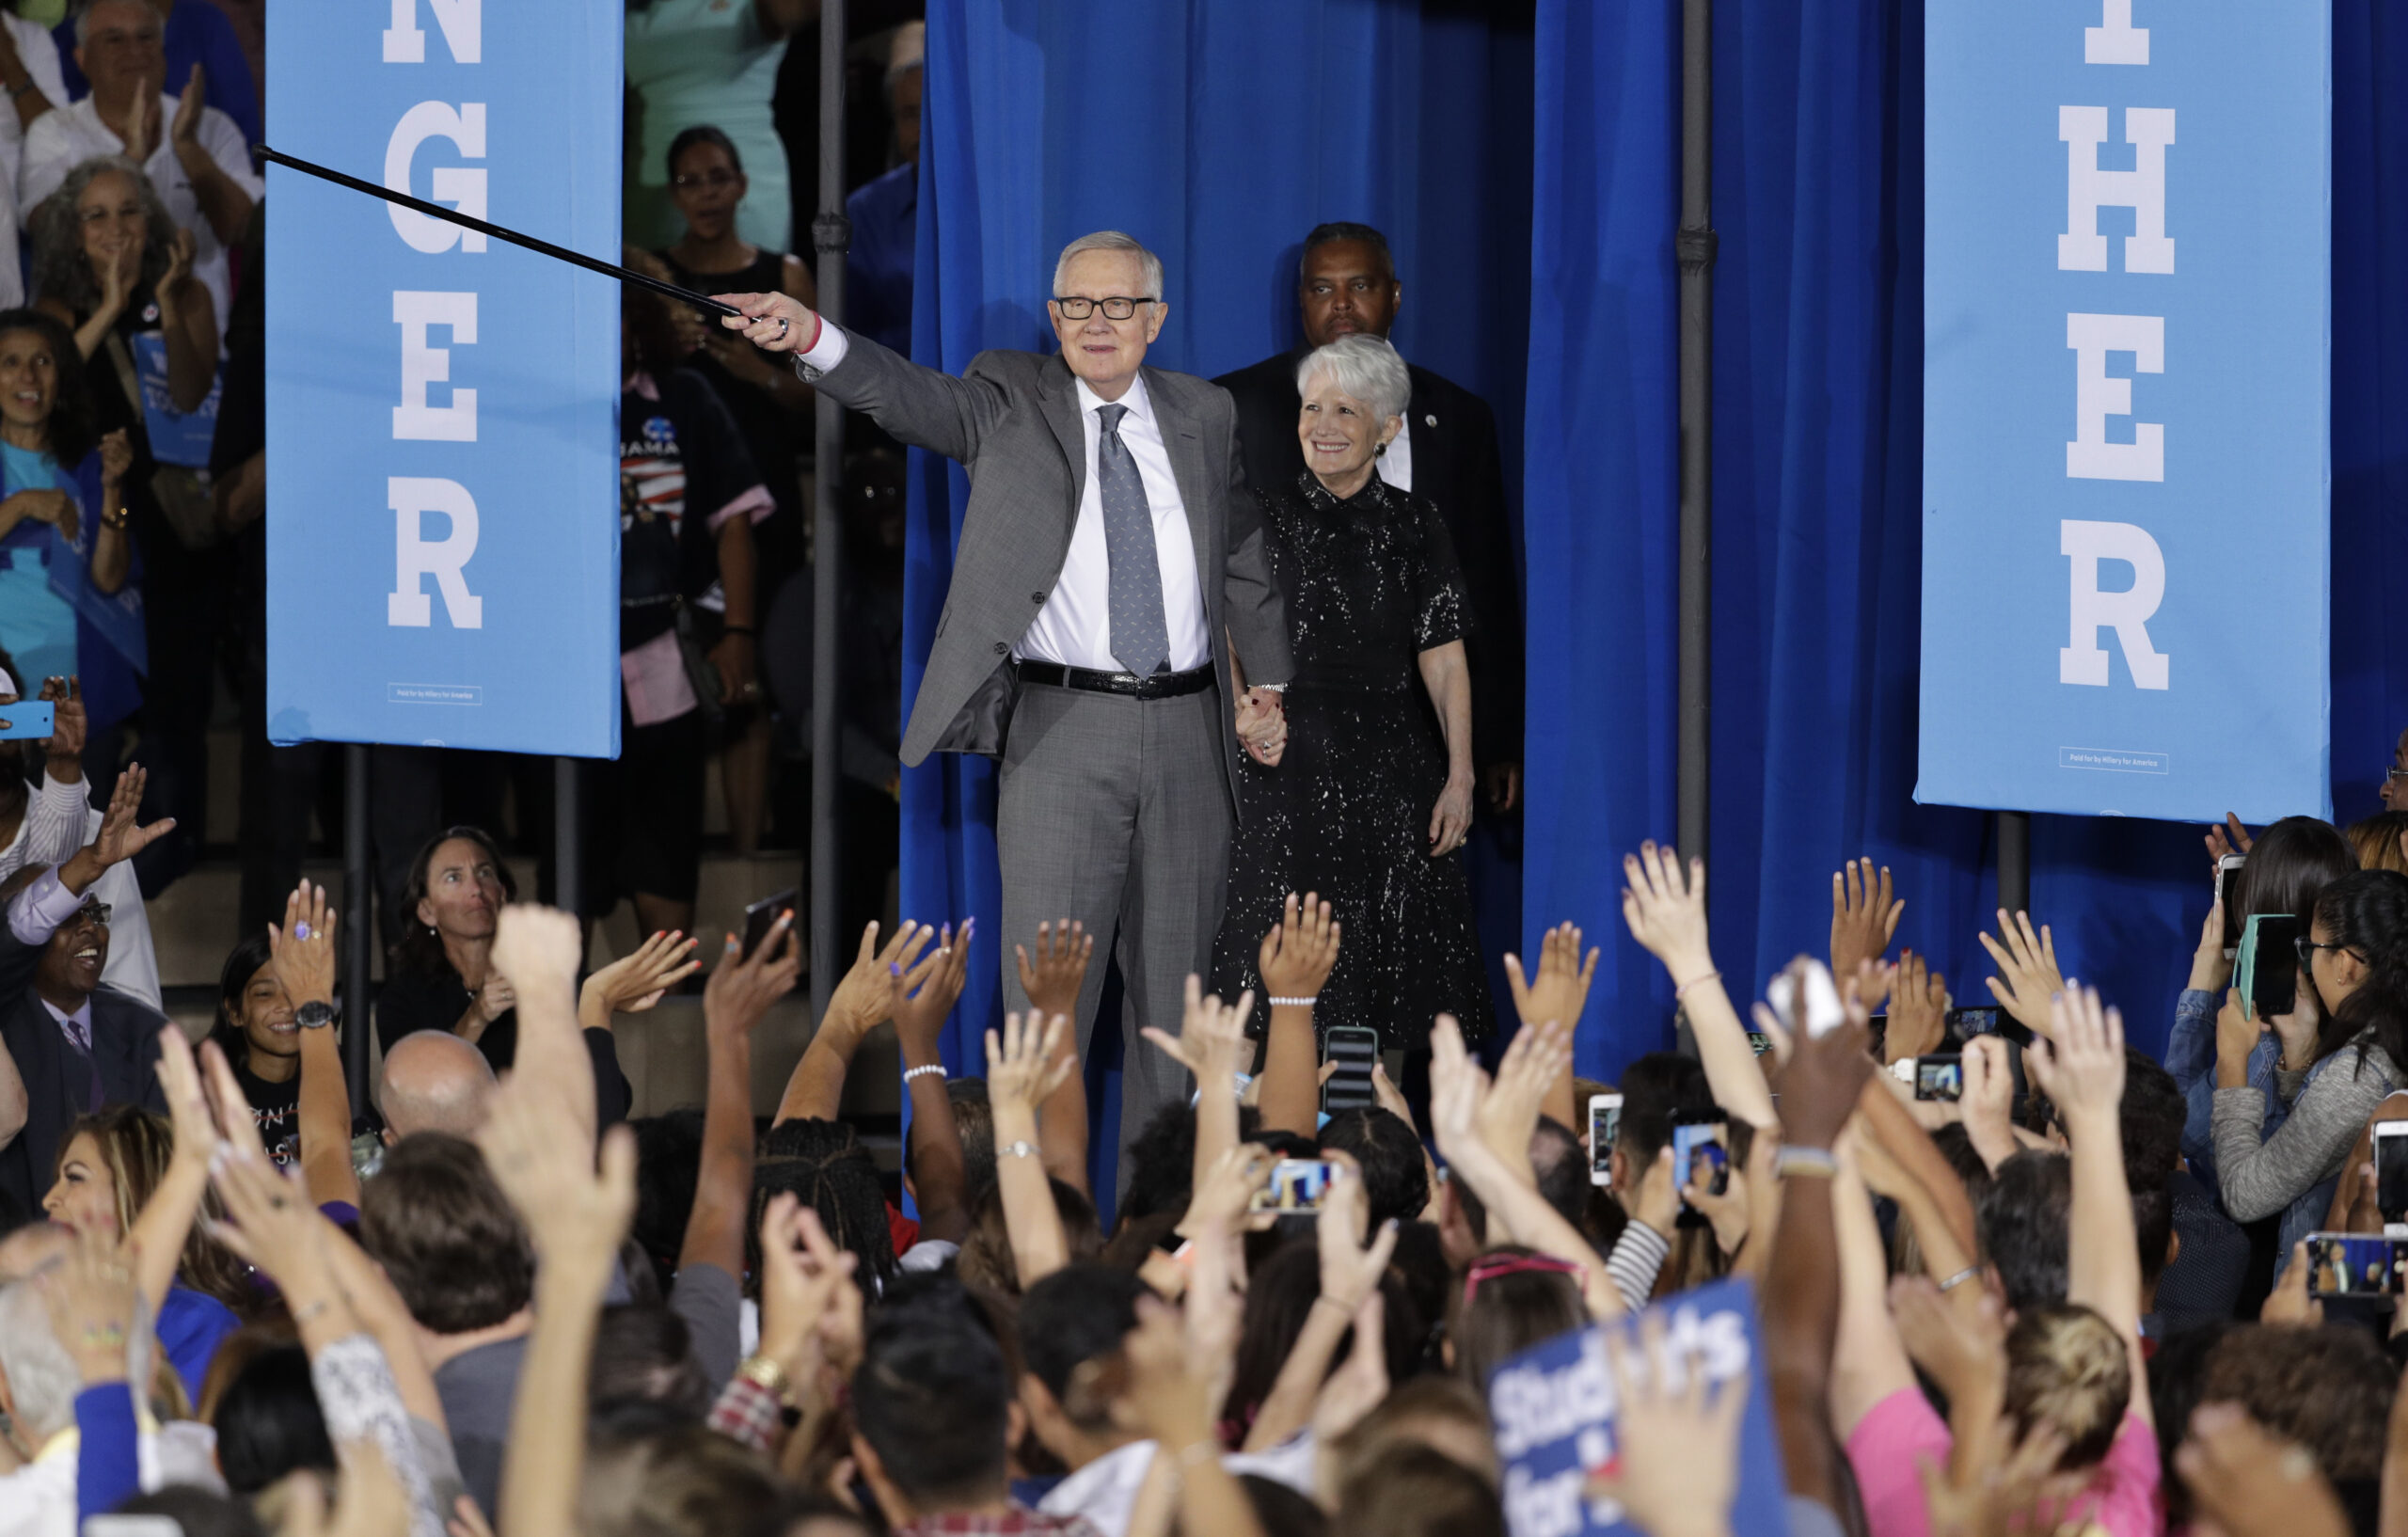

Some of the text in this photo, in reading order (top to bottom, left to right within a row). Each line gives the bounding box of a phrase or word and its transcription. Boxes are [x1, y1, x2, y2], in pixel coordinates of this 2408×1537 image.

[2069, 753, 2083, 762] Paid
[2093, 754, 2101, 765] by
[2102, 755, 2122, 766] Hillary
[2122, 756, 2131, 765] for
[2132, 757, 2158, 768] America
